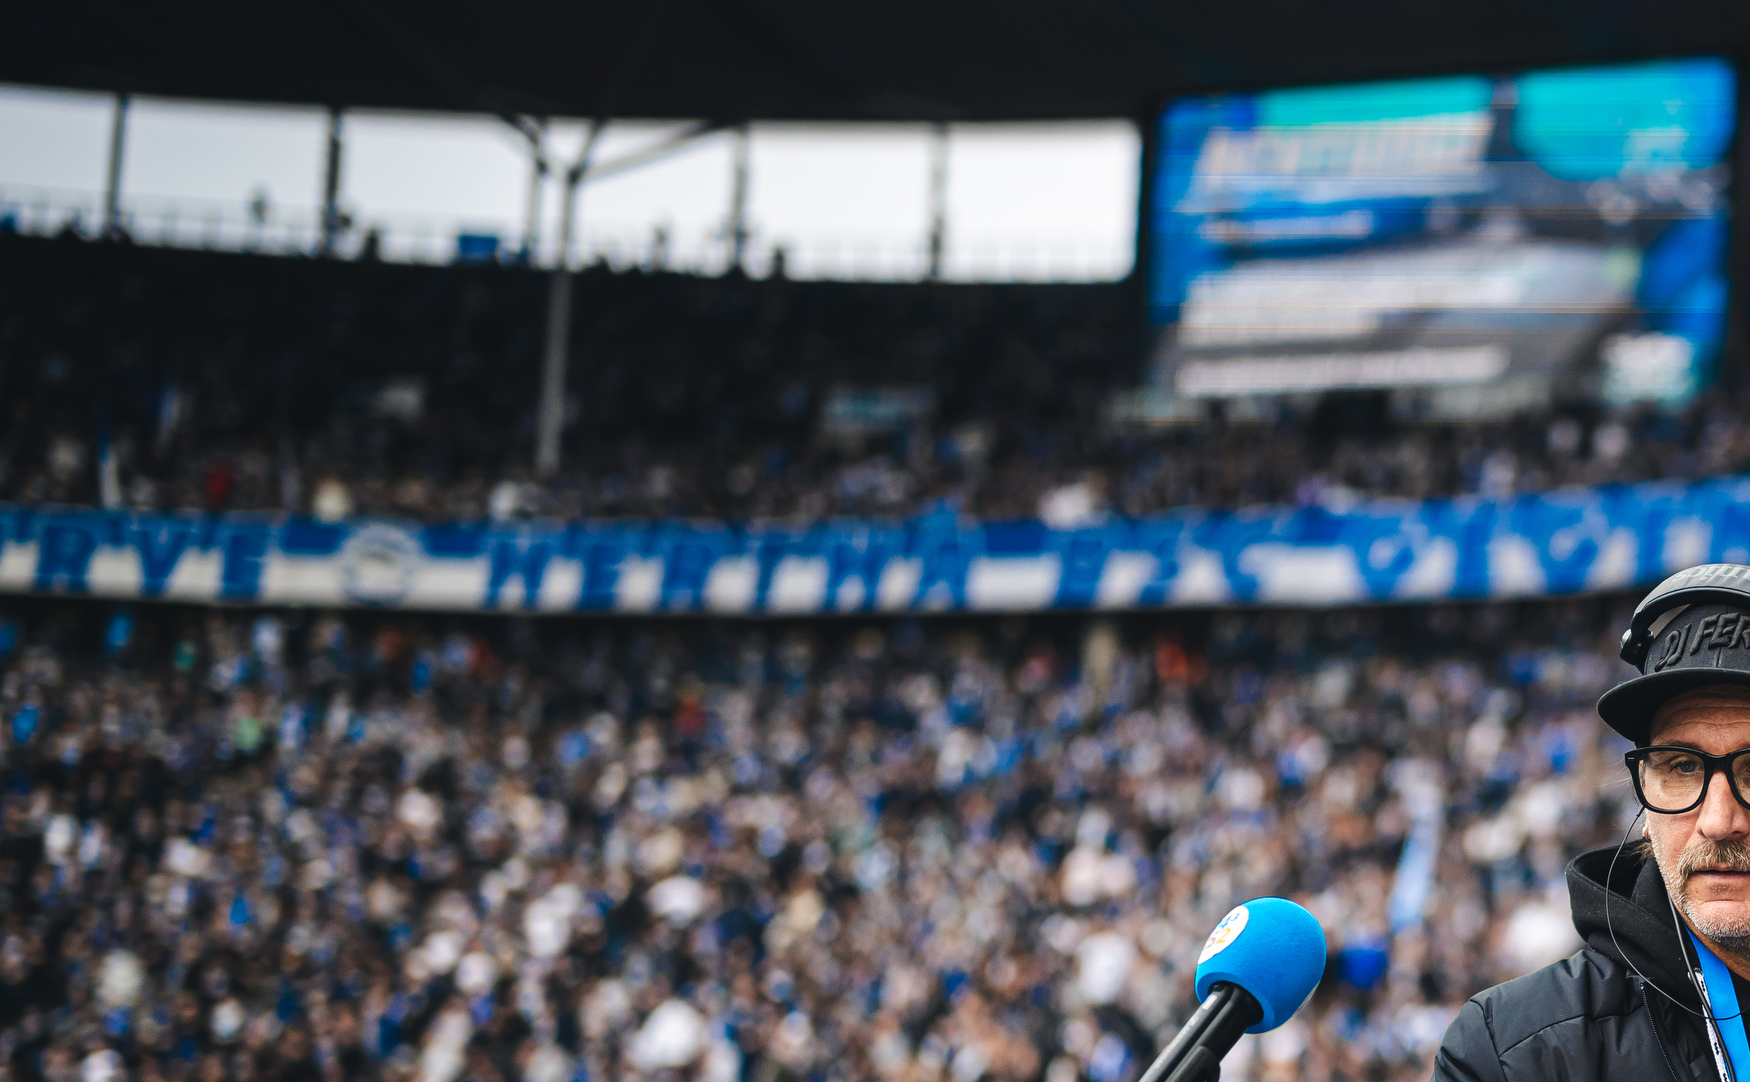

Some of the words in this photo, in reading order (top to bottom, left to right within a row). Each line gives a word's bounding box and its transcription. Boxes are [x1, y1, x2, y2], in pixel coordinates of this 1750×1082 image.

[0, 512, 270, 598] RVE
[490, 518, 982, 610] HERTHA
[1654, 623, 1692, 672] DJ
